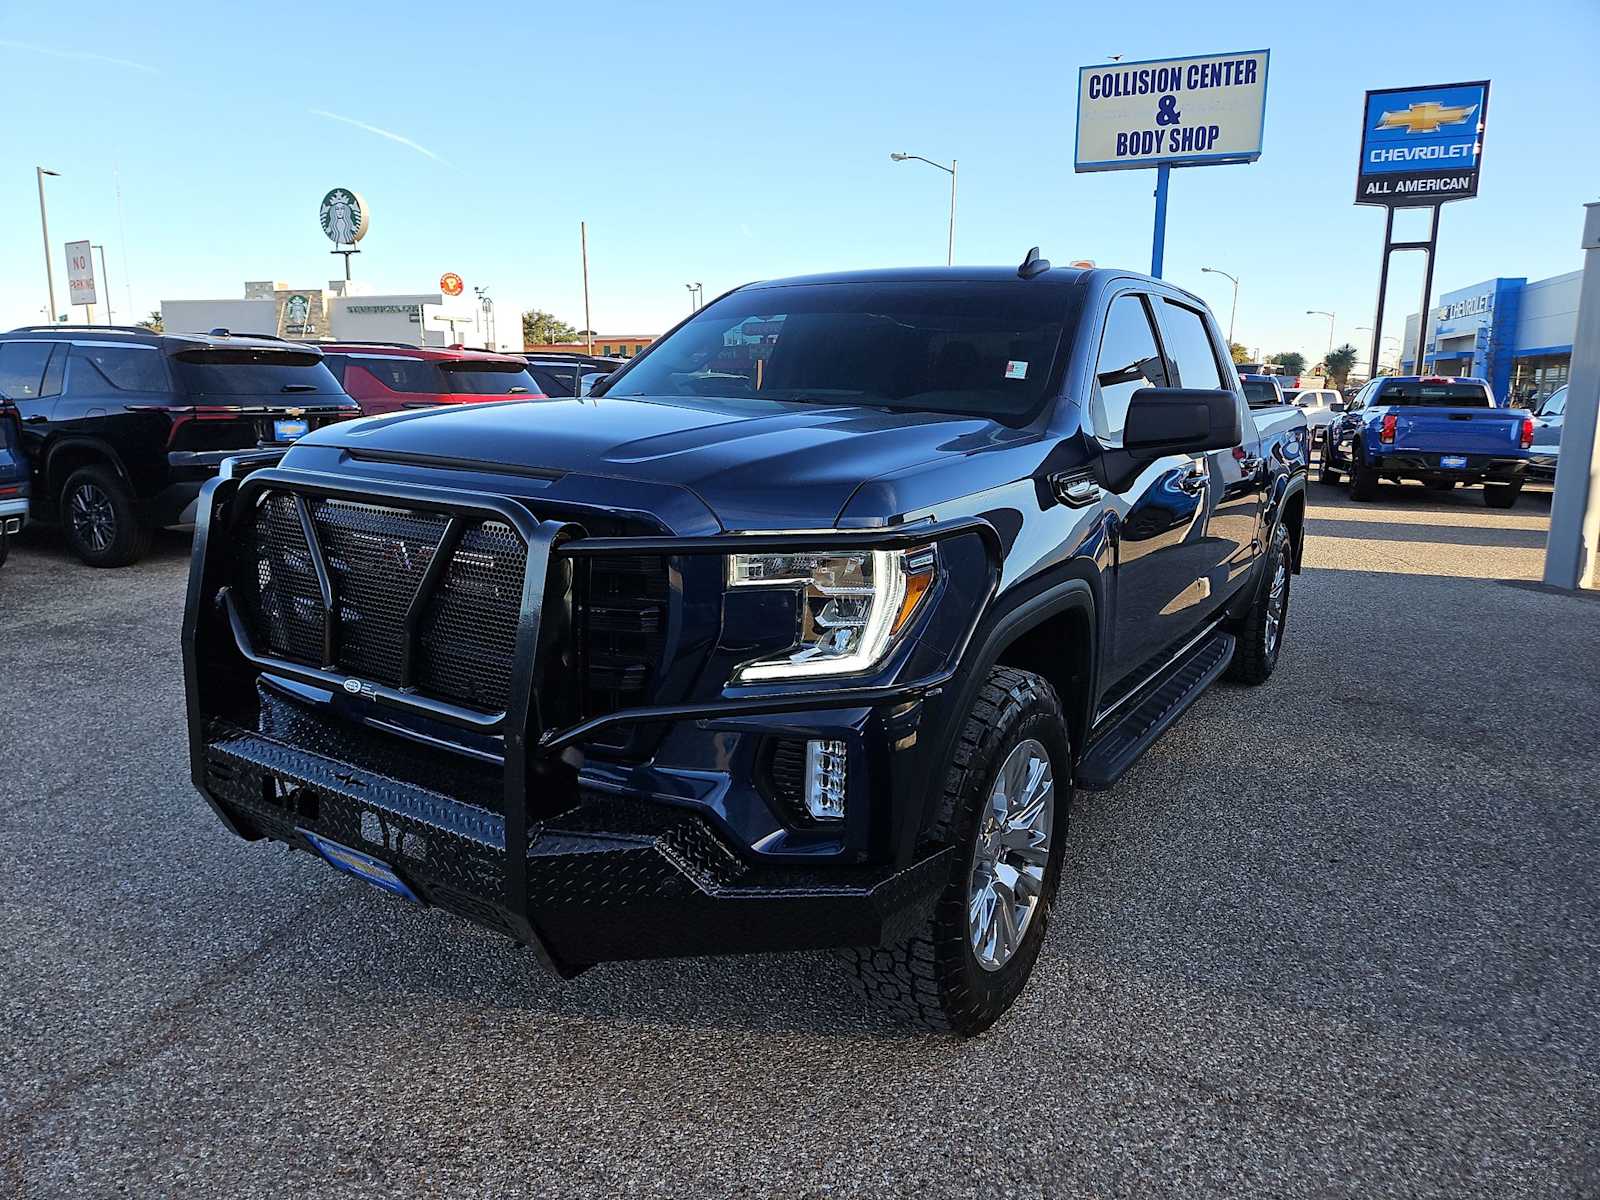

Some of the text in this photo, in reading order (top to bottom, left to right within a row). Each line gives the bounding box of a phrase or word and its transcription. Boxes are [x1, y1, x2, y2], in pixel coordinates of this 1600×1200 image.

[1089, 59, 1257, 99] COLLISION CENTER
[1156, 95, 1180, 126] &
[1116, 125, 1220, 156] BODY SHOP
[1370, 144, 1472, 162] CHEVROLET
[1366, 177, 1469, 194] ALL AMERICAN
[72, 256, 86, 270] NO
